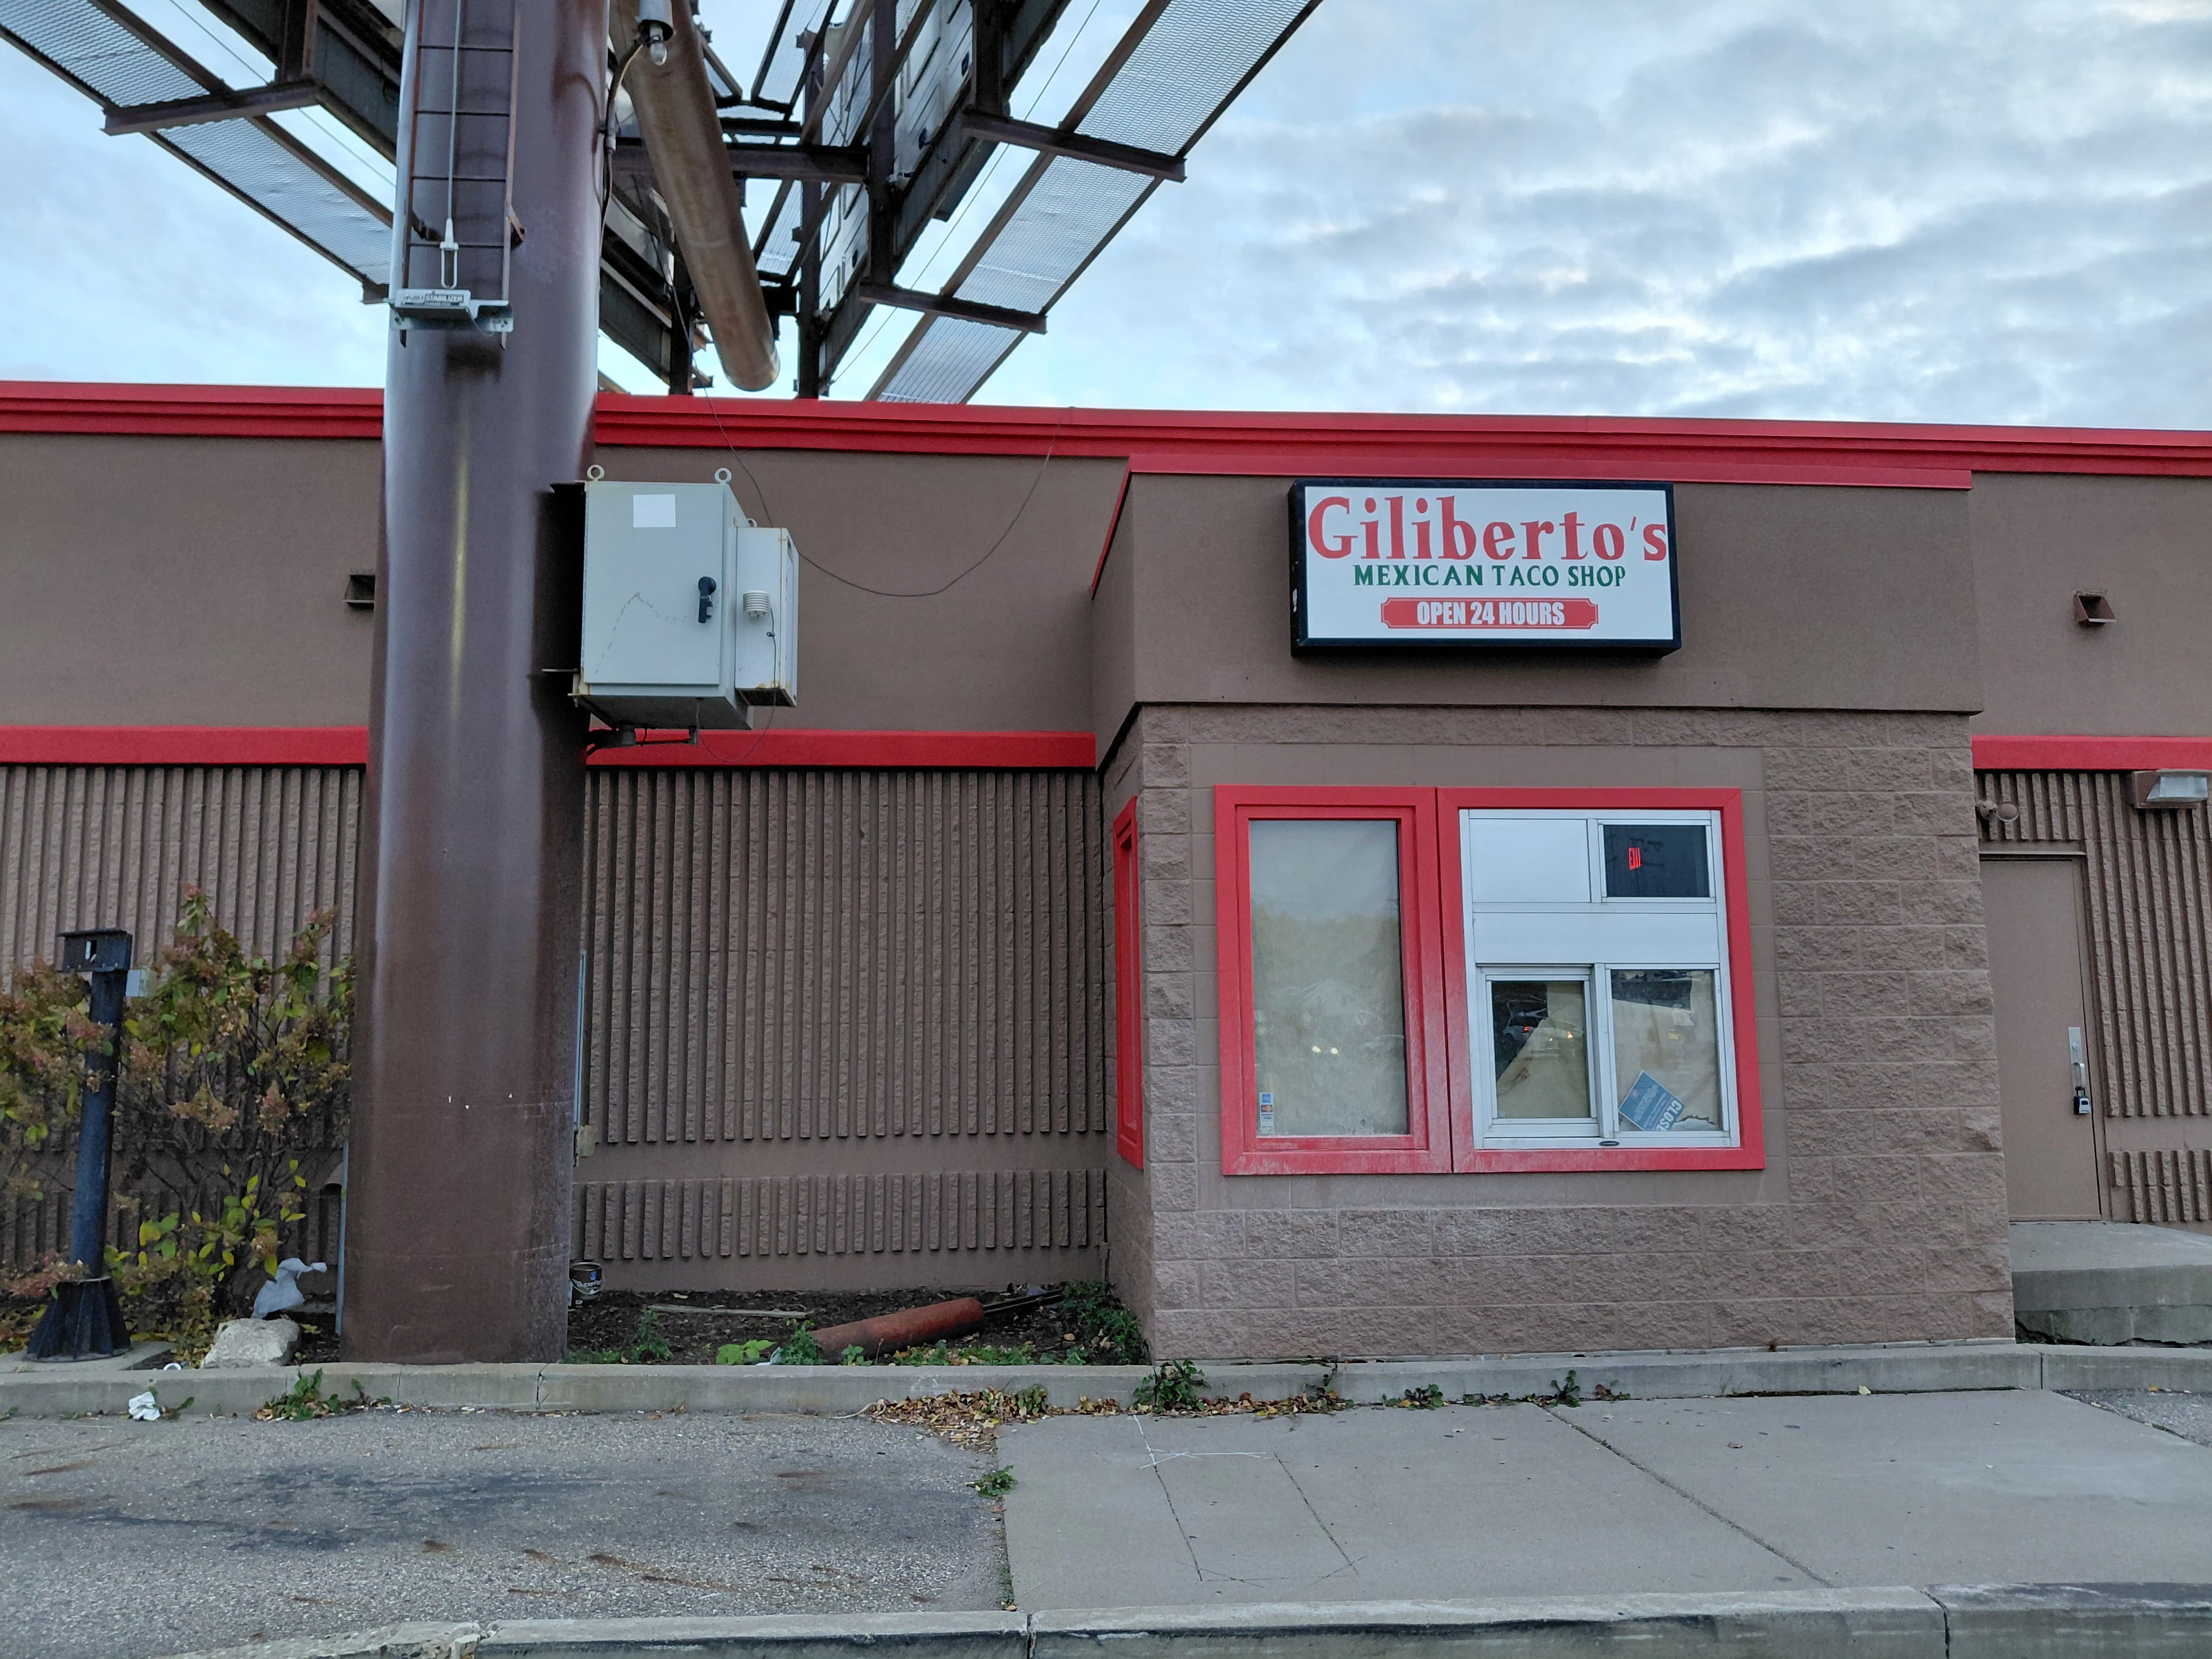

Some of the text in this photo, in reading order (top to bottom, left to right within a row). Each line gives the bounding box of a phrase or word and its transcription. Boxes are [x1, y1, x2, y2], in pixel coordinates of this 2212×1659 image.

[1308, 495, 1667, 561] Giliberto's
[1353, 565, 1626, 587] MEXICAN TACO SHOP
[1417, 602, 1565, 625] OPEN 24 HOURS
[1655, 1099, 1682, 1131] CLOSE
